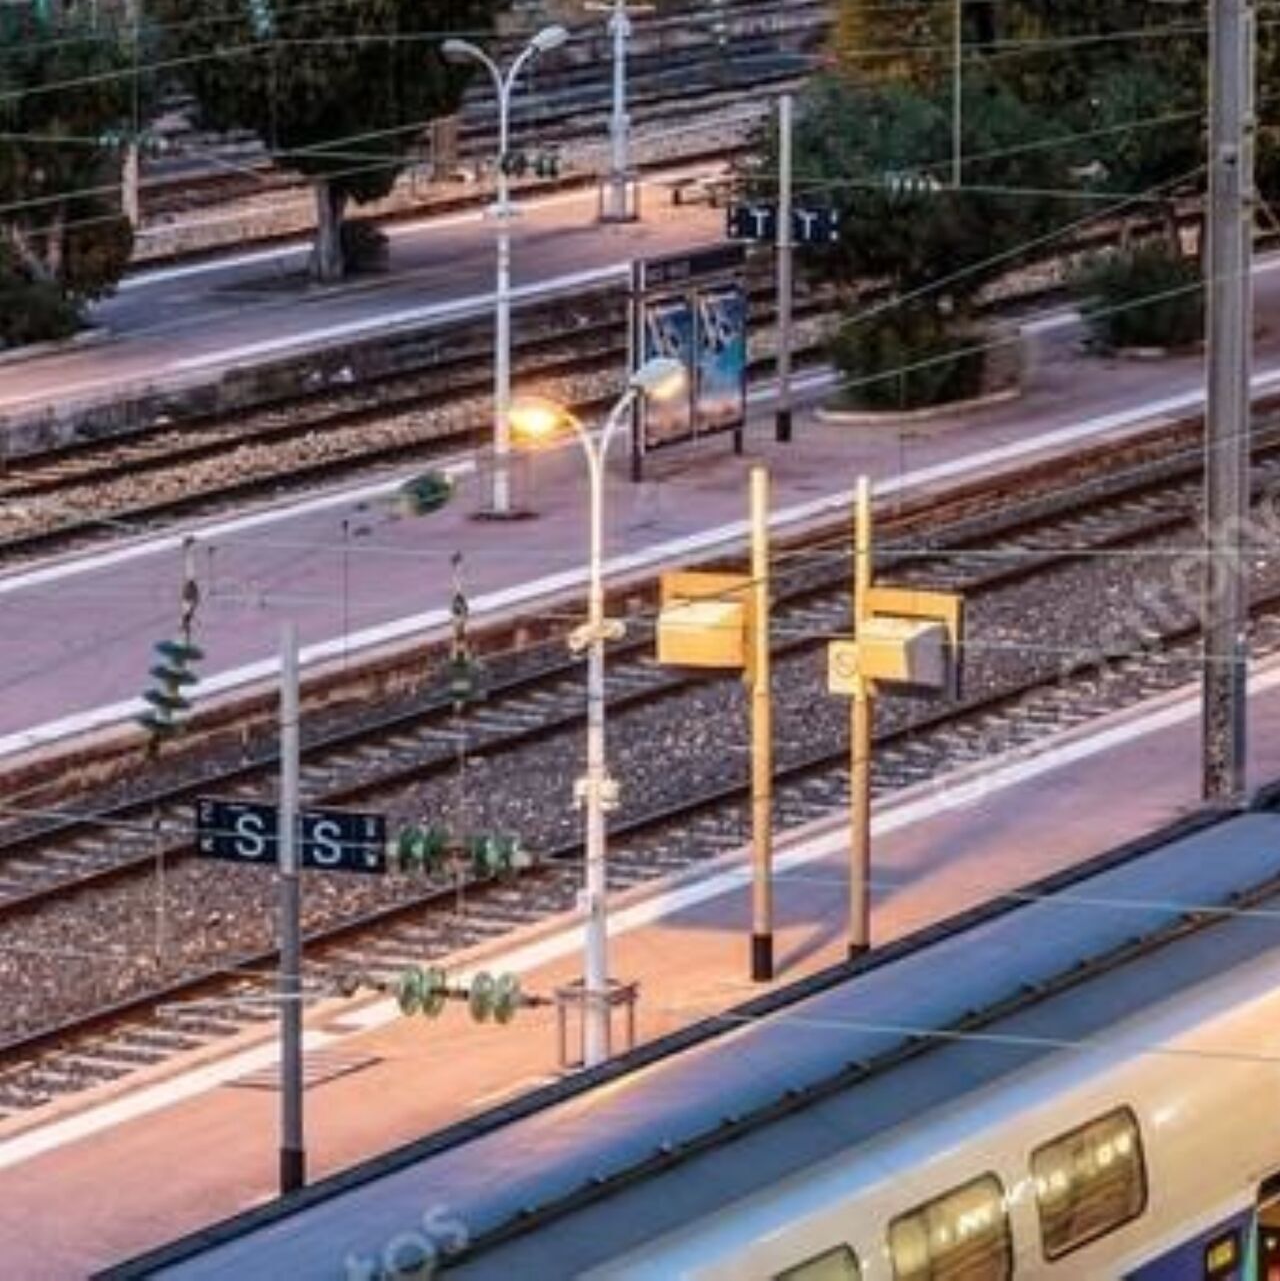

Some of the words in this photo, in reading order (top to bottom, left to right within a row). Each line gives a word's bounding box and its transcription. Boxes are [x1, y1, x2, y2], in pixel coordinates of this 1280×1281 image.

[750, 207, 770, 237] T
[798, 211, 818, 240] T
[234, 813, 264, 857] S
[312, 820, 342, 864] S
